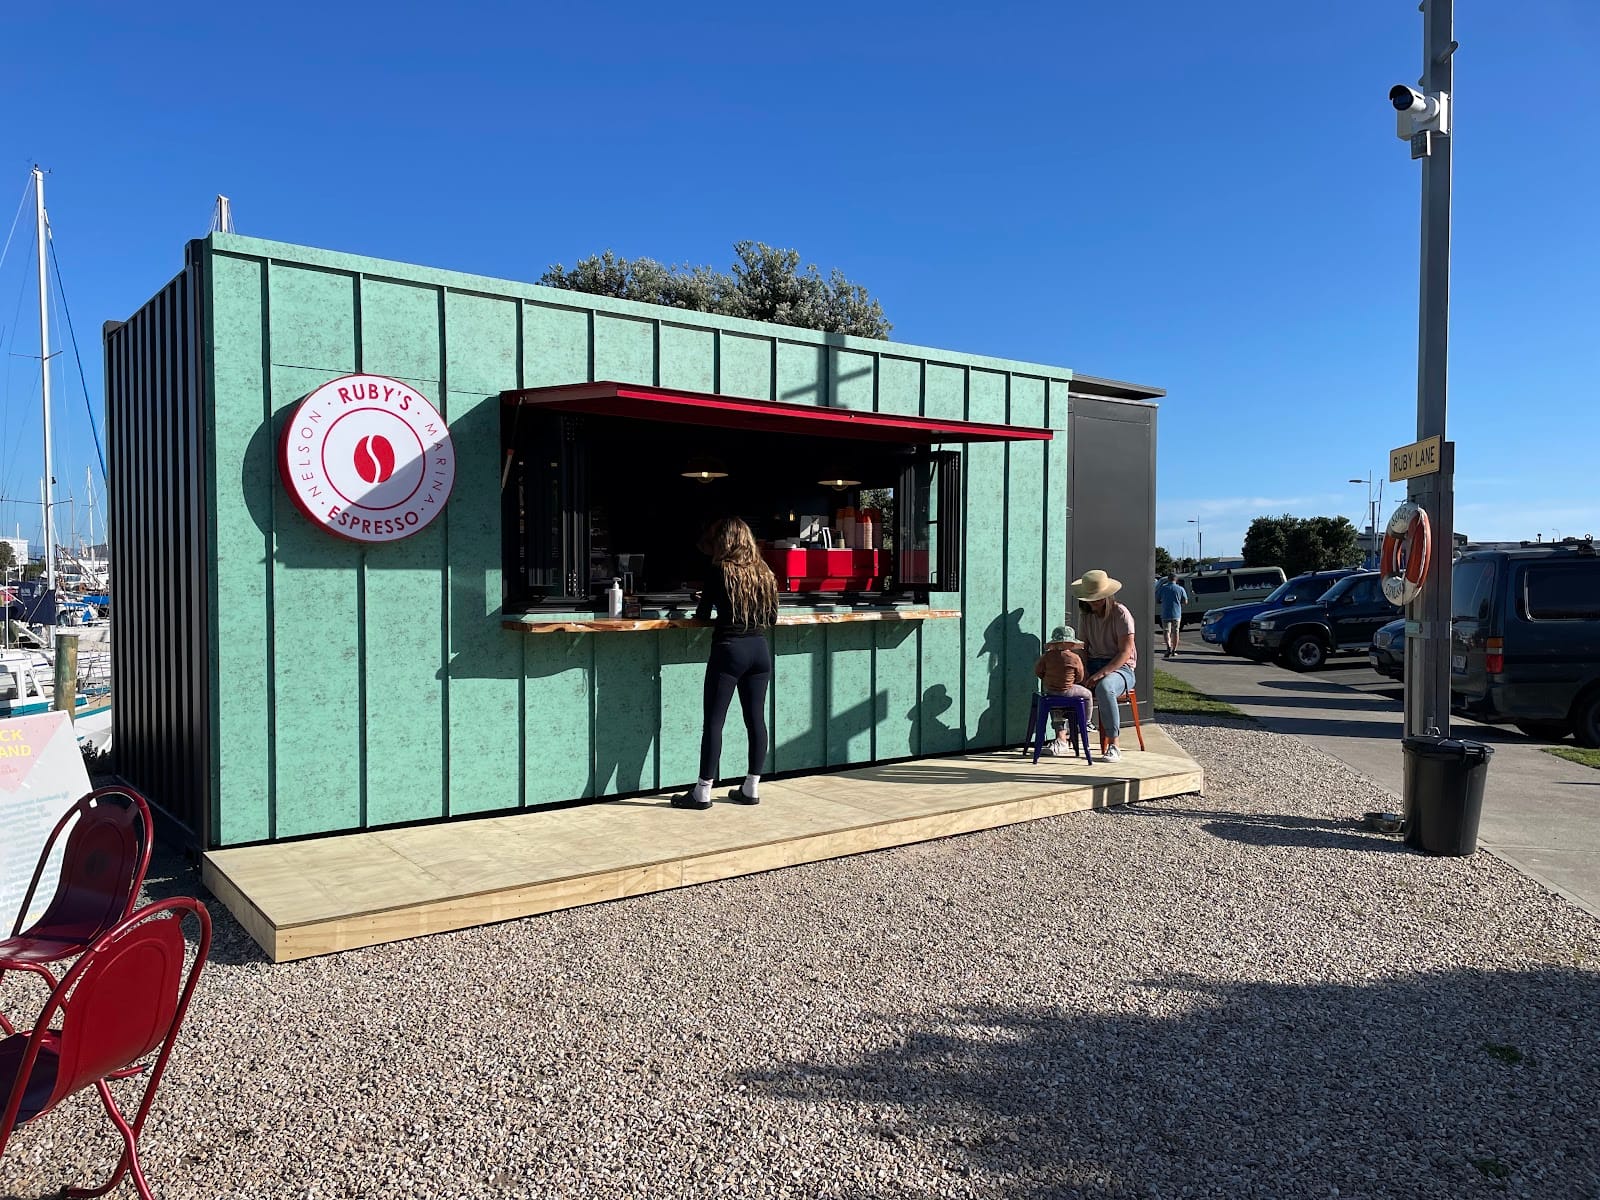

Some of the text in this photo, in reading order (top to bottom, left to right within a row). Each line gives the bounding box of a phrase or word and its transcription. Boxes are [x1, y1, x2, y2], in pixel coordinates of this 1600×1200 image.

[338, 384, 412, 411] RUBY'S
[298, 410, 322, 498] NELSON
[424, 423, 448, 504] MARINA
[1393, 445, 1435, 473] RUBY LANE
[327, 505, 419, 534] ESPRESSO
